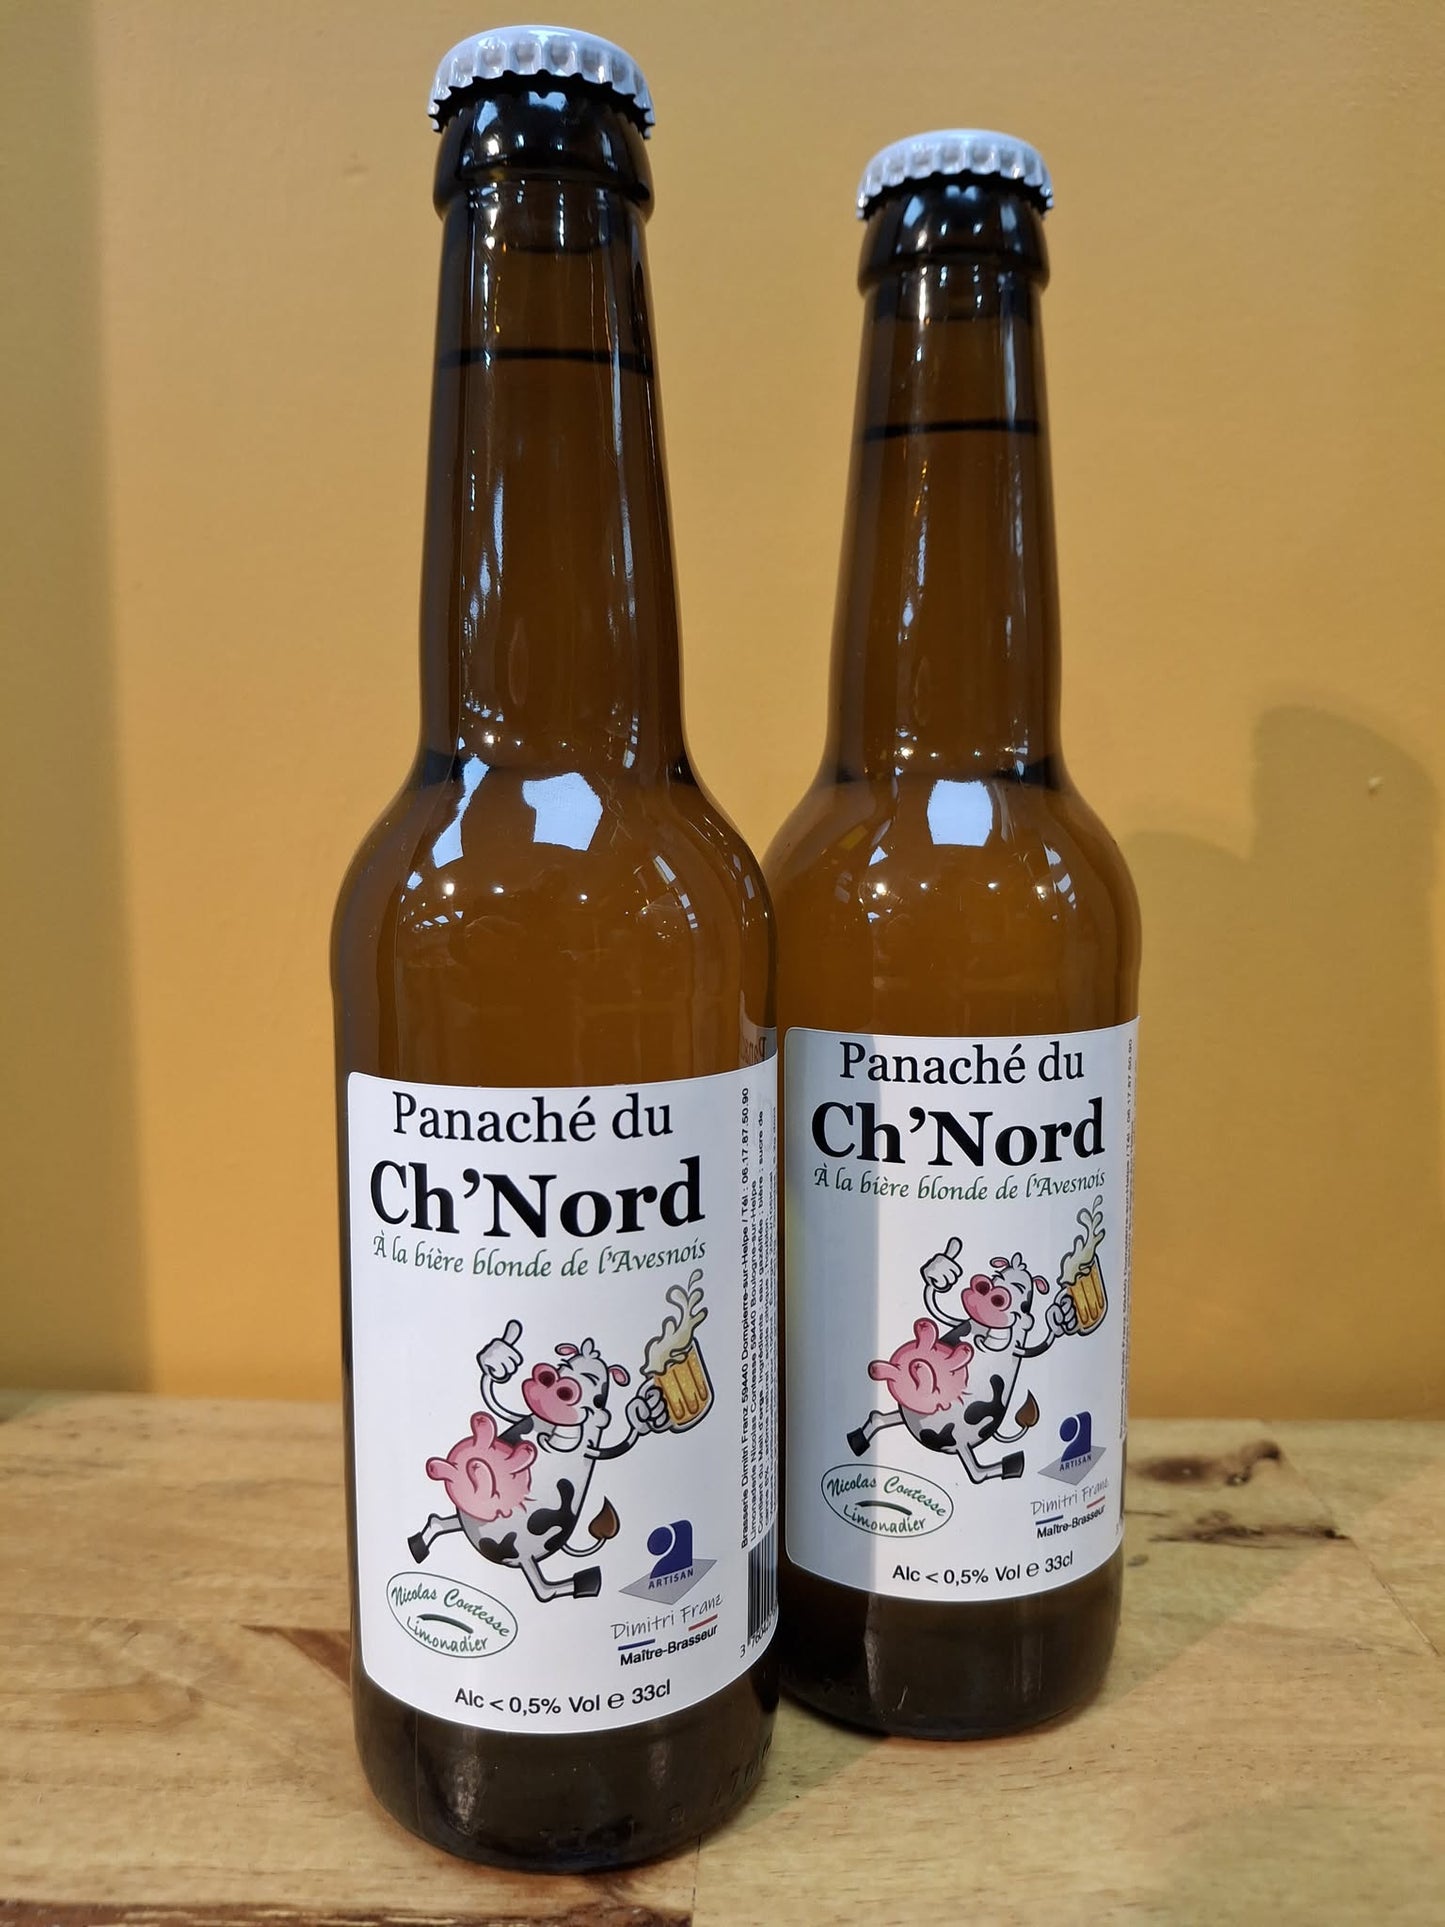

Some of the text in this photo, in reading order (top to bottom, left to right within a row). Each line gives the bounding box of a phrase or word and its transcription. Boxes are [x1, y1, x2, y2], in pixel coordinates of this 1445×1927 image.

[840, 1041, 1084, 1084] Panaché du
[392, 1091, 673, 1143] Panaché du
[741, 1088, 749, 1184] 06.17.87.50.90
[812, 1097, 1106, 1166] Ch'Nord
[371, 1155, 705, 1238] Ch'Nord
[813, 1163, 1106, 1200] À la bière blonde de l'Avesnois
[741, 1195, 749, 1216] Tél
[373, 1230, 706, 1277] À la bière blonde de l'Avesnois
[741, 1226, 749, 1361] Dompierre-sur-Helpe
[741, 1363, 749, 1404] 59440
[741, 1405, 749, 1444] Franz
[741, 1445, 749, 1487] Dimitri
[1059, 1454, 1092, 1472] ARTISAN
[827, 1474, 946, 1518] Nicolas Contesse
[1031, 1491, 1077, 1516] Dimitri
[741, 1488, 749, 1549] Brasserie
[842, 1503, 926, 1533] Limonadier
[1036, 1505, 1105, 1539] Maître-Brasseur
[648, 1569, 695, 1590] ARTISAN
[892, 1565, 920, 1582] Alc
[926, 1573, 938, 1583] <
[944, 1568, 988, 1587] 0,5%
[995, 1562, 1020, 1582] Vol
[1045, 1550, 1073, 1574] 33cl
[390, 1582, 510, 1638] Nicolas Contesse
[611, 1593, 723, 1640] Dimitri Franz
[406, 1616, 489, 1653] Limonadier
[619, 1624, 718, 1666] Maître-Brasseur
[455, 1687, 485, 1709] Alc
[489, 1699, 503, 1712] <
[509, 1696, 561, 1717] 0,5%
[569, 1694, 600, 1713] Vol
[631, 1678, 671, 1705] 33cl
